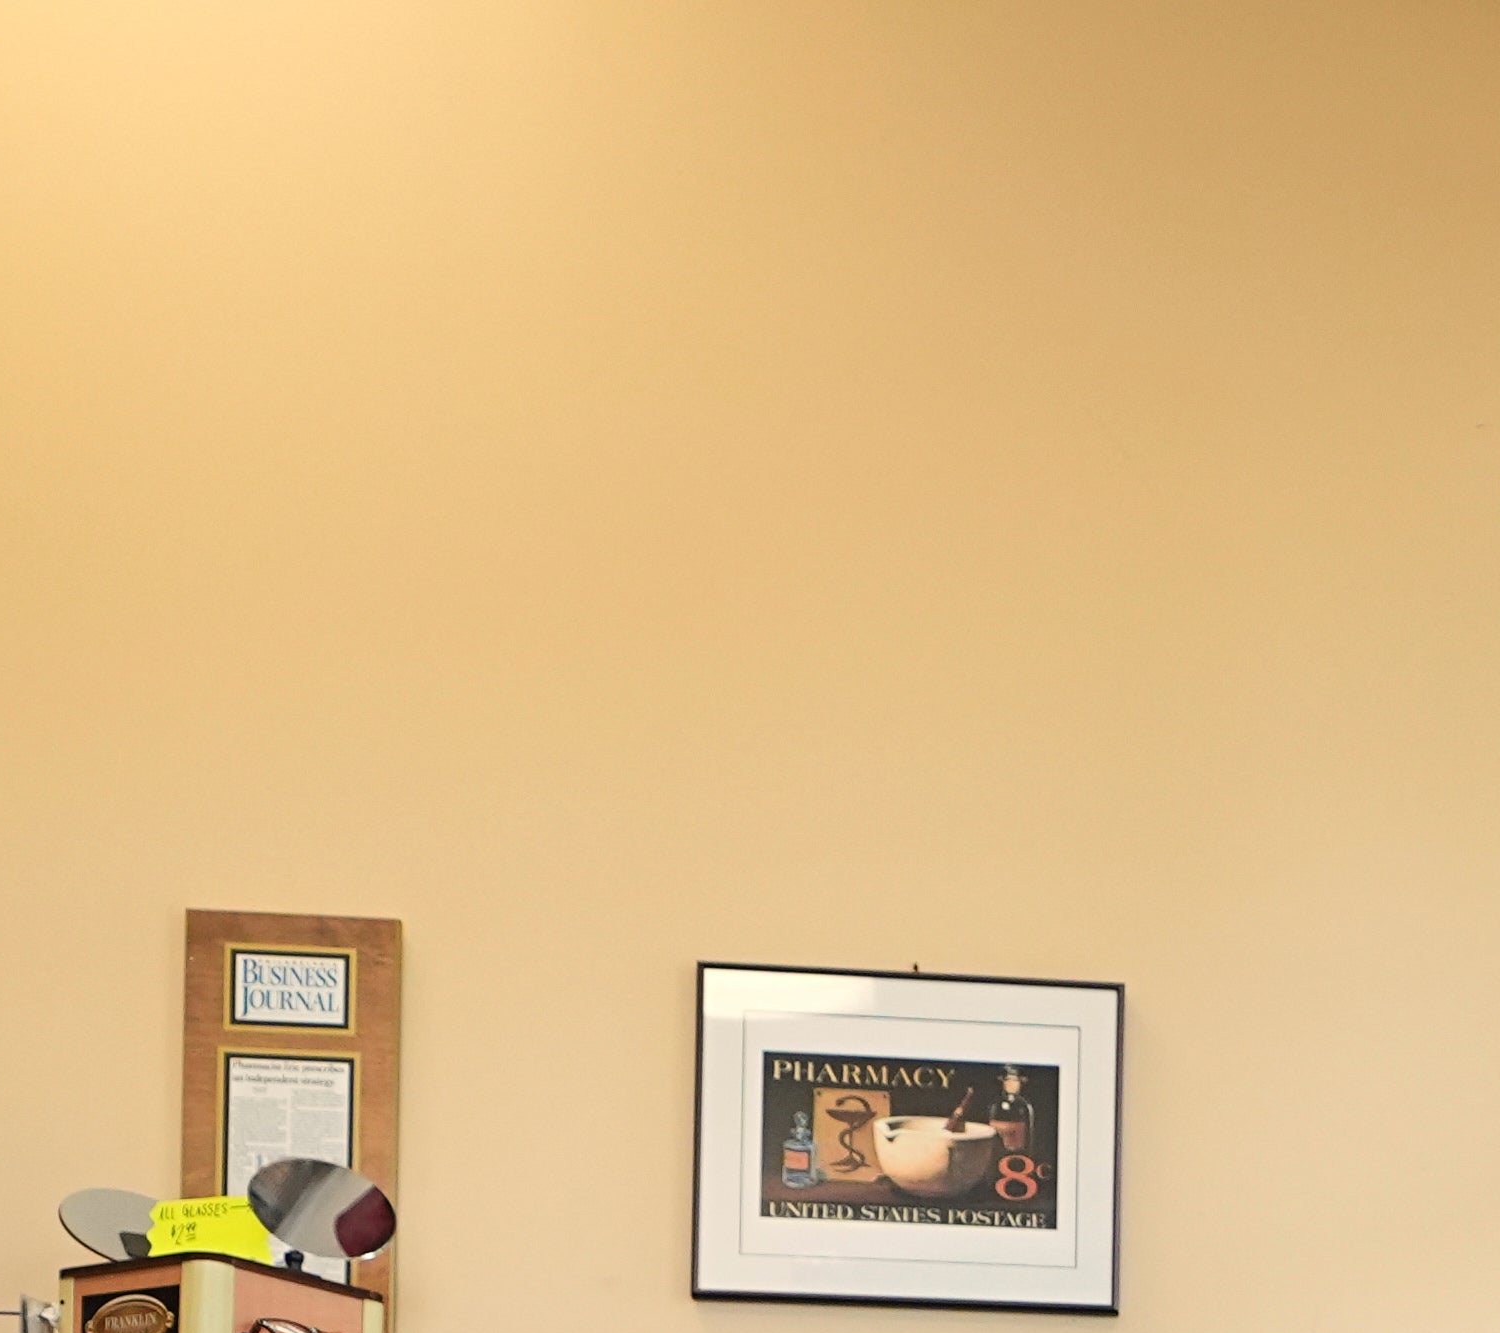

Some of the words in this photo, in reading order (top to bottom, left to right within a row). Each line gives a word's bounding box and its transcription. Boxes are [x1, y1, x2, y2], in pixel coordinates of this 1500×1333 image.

[243, 958, 338, 988] BUSINESS
[241, 986, 339, 1016] JOURNAL
[772, 1058, 955, 1089] PHARMACY
[159, 1206, 175, 1220] ALL
[182, 1202, 228, 1218] GLASSES
[768, 1200, 854, 1220] UNITED
[860, 1204, 941, 1224] STATES
[948, 1207, 1047, 1229] POSTAGE
[104, 1312, 157, 1331] FRANKLIN
